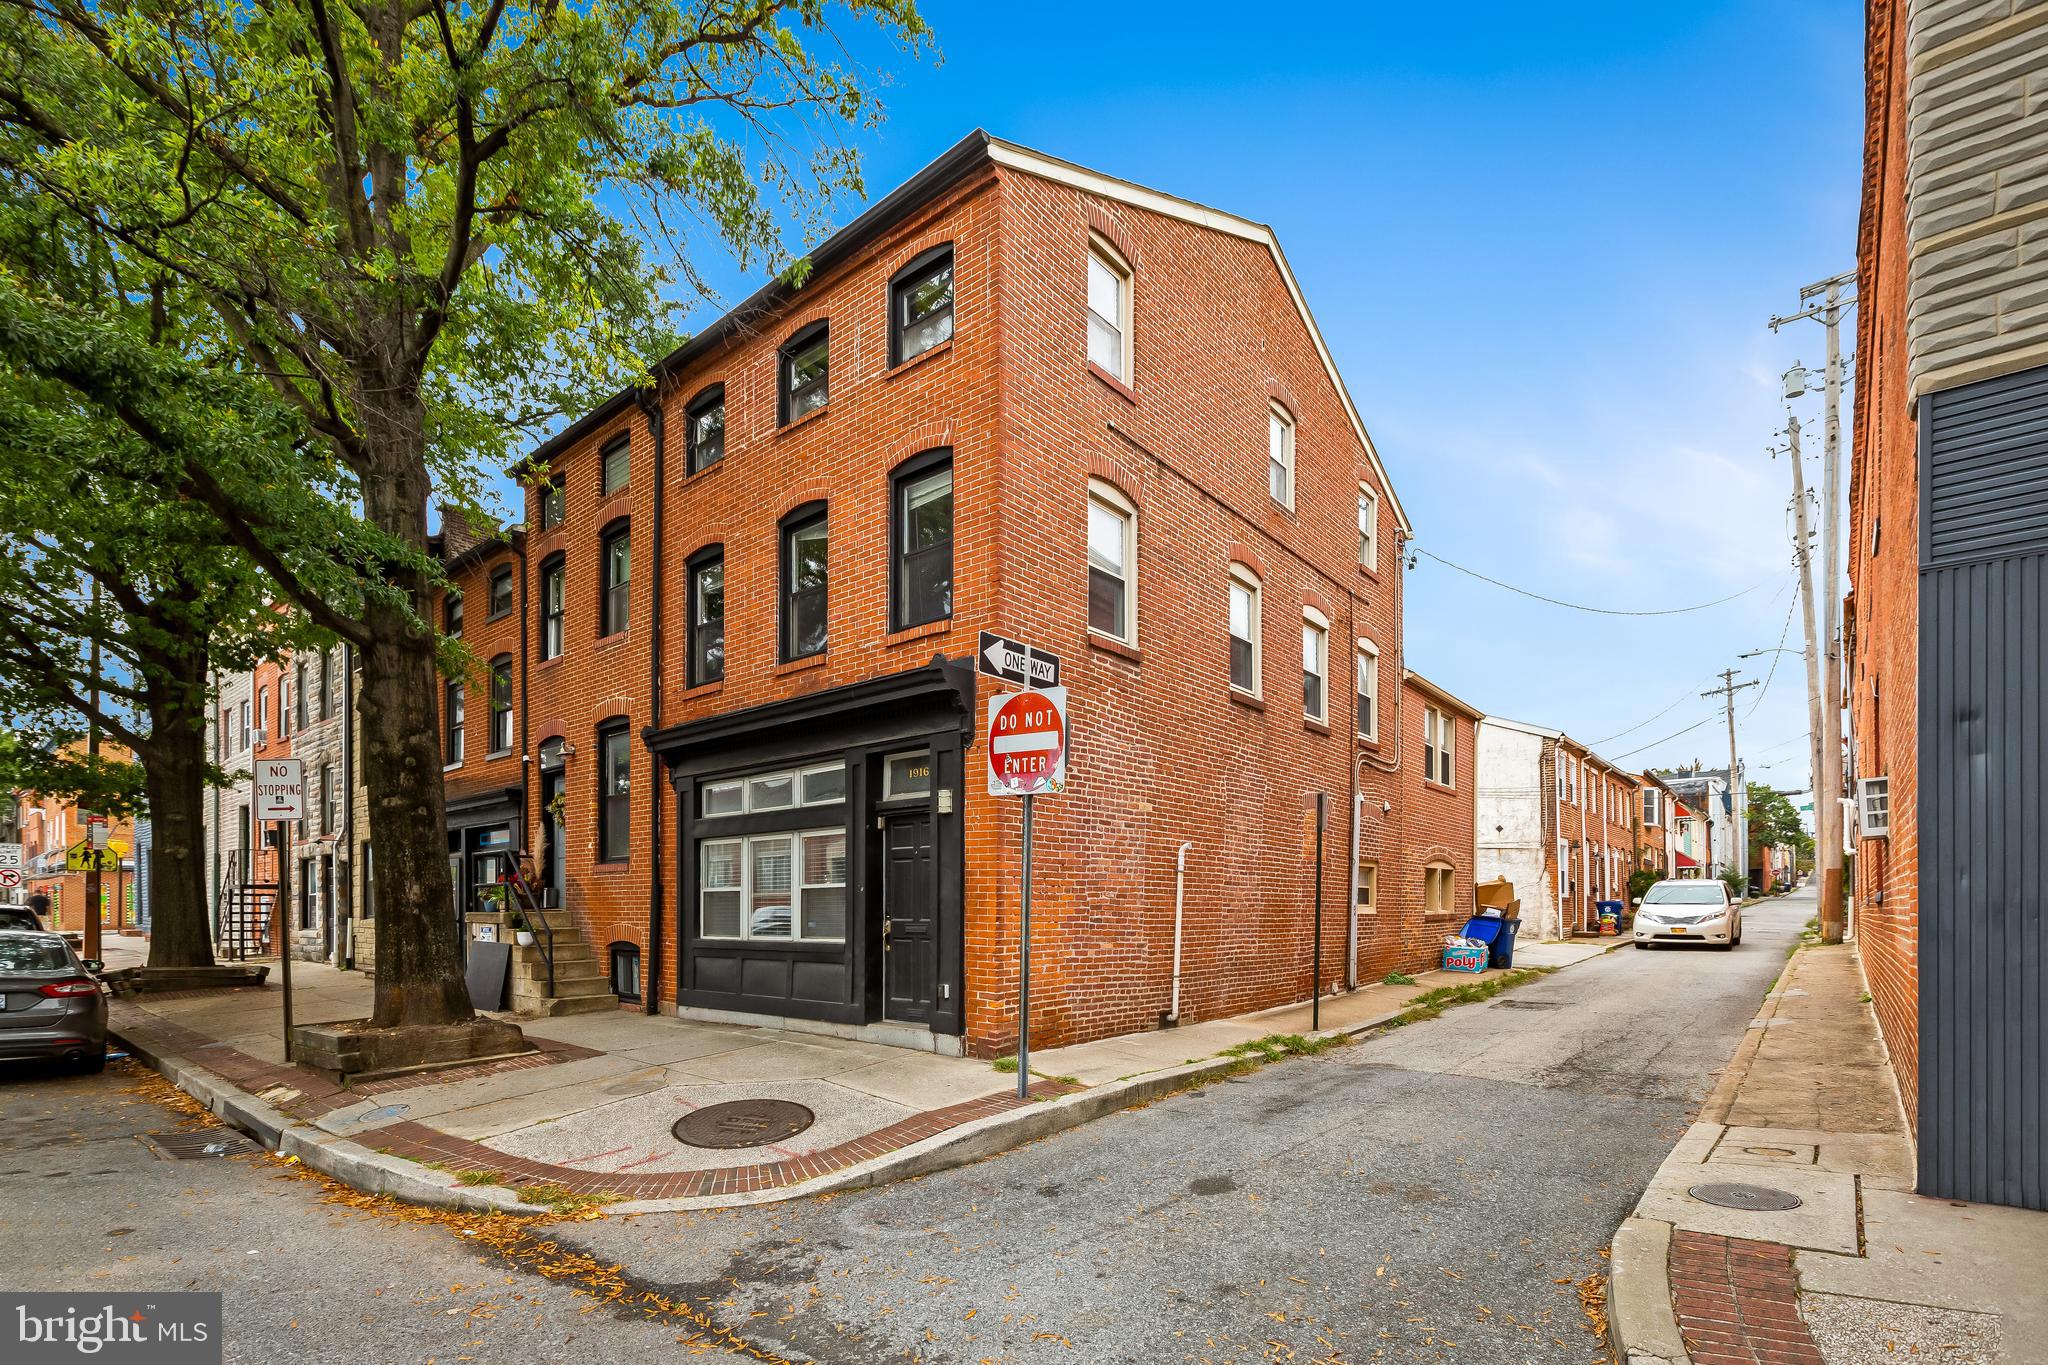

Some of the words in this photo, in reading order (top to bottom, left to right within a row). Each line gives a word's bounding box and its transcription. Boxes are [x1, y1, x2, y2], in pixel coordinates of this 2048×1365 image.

[1004, 652, 1025, 672] ONE
[1030, 660, 1052, 679] WAY
[1000, 713, 1017, 731] DO
[1025, 709, 1053, 728] NOT
[270, 766, 288, 777] NO
[1004, 756, 1047, 774] ENTER
[909, 766, 930, 779] 1916
[258, 784, 301, 796] STOPPING
[0, 855, 18, 864] 25
